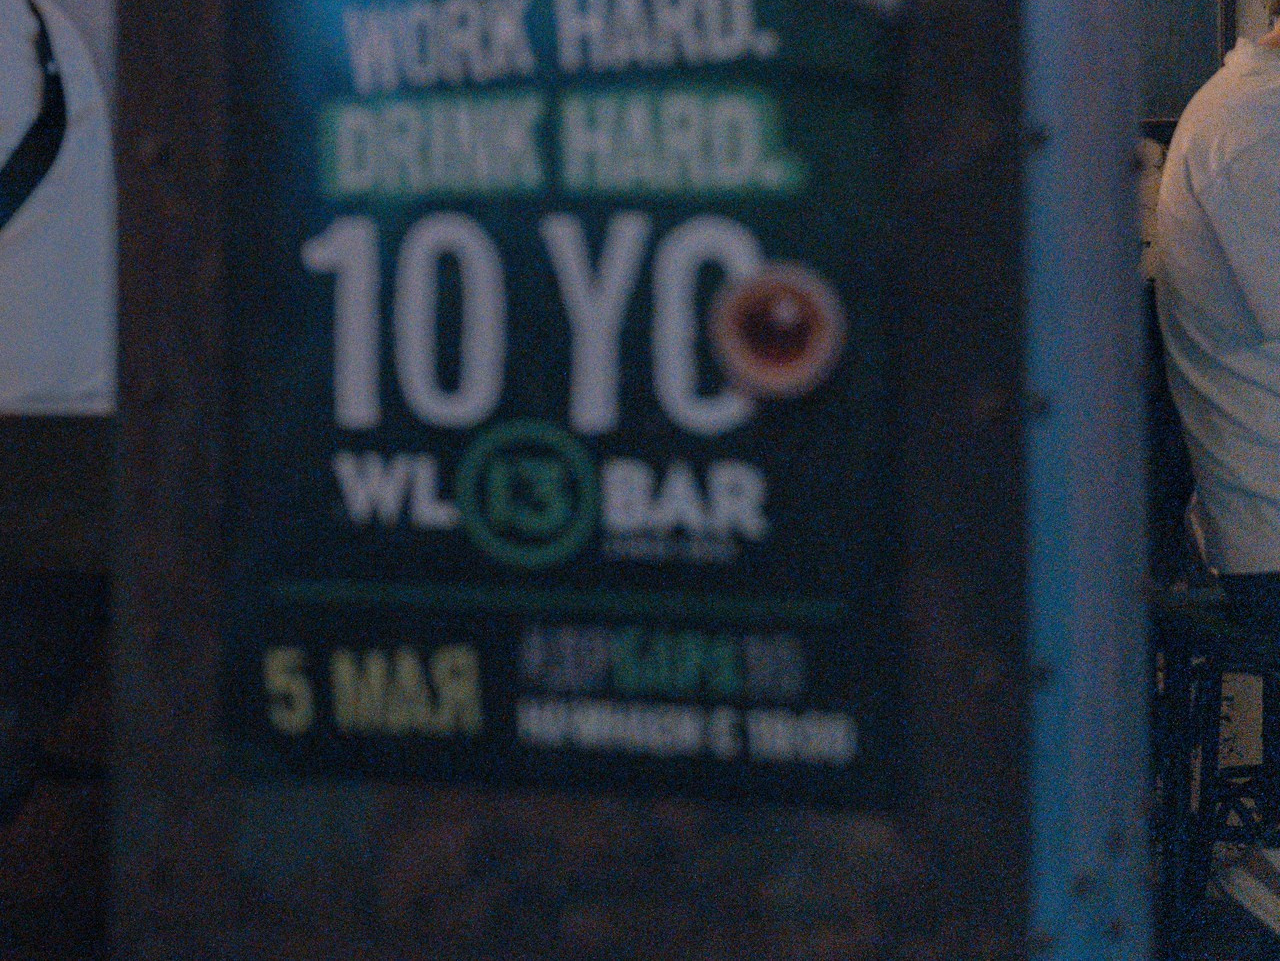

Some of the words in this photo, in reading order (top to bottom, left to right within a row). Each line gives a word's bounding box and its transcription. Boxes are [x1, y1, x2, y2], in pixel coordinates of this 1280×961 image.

[334, 90, 544, 194] DRINK
[561, 88, 788, 191] HARD.
[301, 210, 508, 434] 10
[332, 449, 462, 532] WL
[601, 455, 770, 541] BAR
[264, 647, 311, 733] 5
[332, 646, 481, 733] МАЯ
